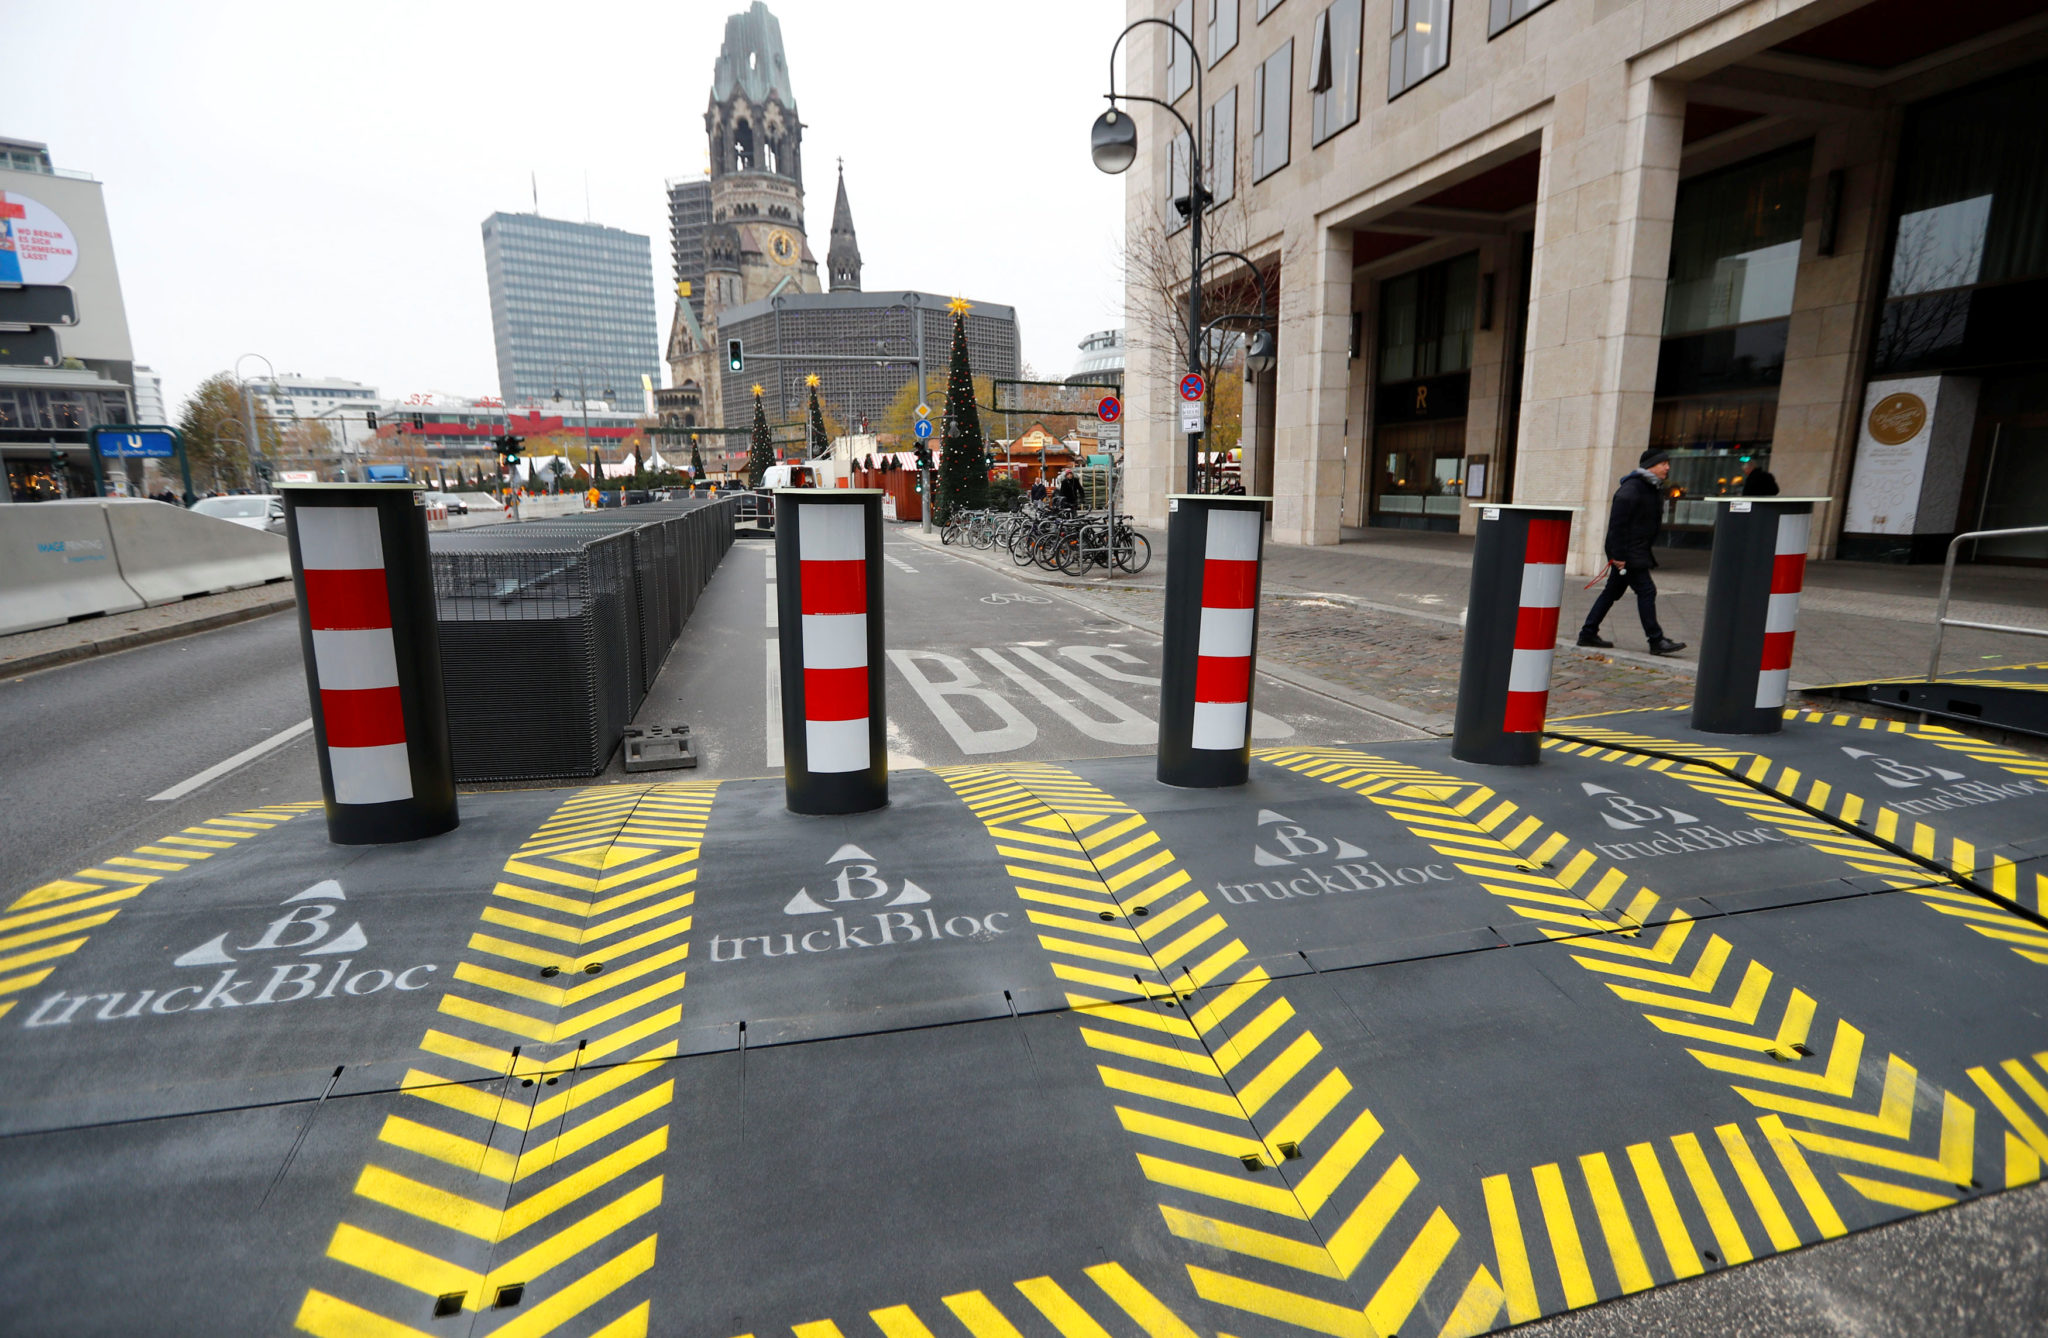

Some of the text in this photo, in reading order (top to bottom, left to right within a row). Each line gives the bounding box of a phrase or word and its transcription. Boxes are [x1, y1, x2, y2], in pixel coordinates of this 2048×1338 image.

[17, 228, 63, 239] WO BERLIN
[18, 235, 51, 245] ES SICH
[20, 244, 73, 255] SCHMECKEN
[103, 449, 146, 457] Zoolgischer
[126, 434, 143, 449] U
[1605, 796, 1664, 822] B
[1885, 780, 2048, 815] truckBloc
[1275, 825, 1329, 857] B
[1593, 825, 1784, 860] truckBloc
[824, 864, 889, 903] B
[1216, 861, 1455, 904] truckBloc
[237, 904, 337, 951] B
[709, 908, 1010, 963] truckBloc
[23, 958, 438, 1029] truckBloc
